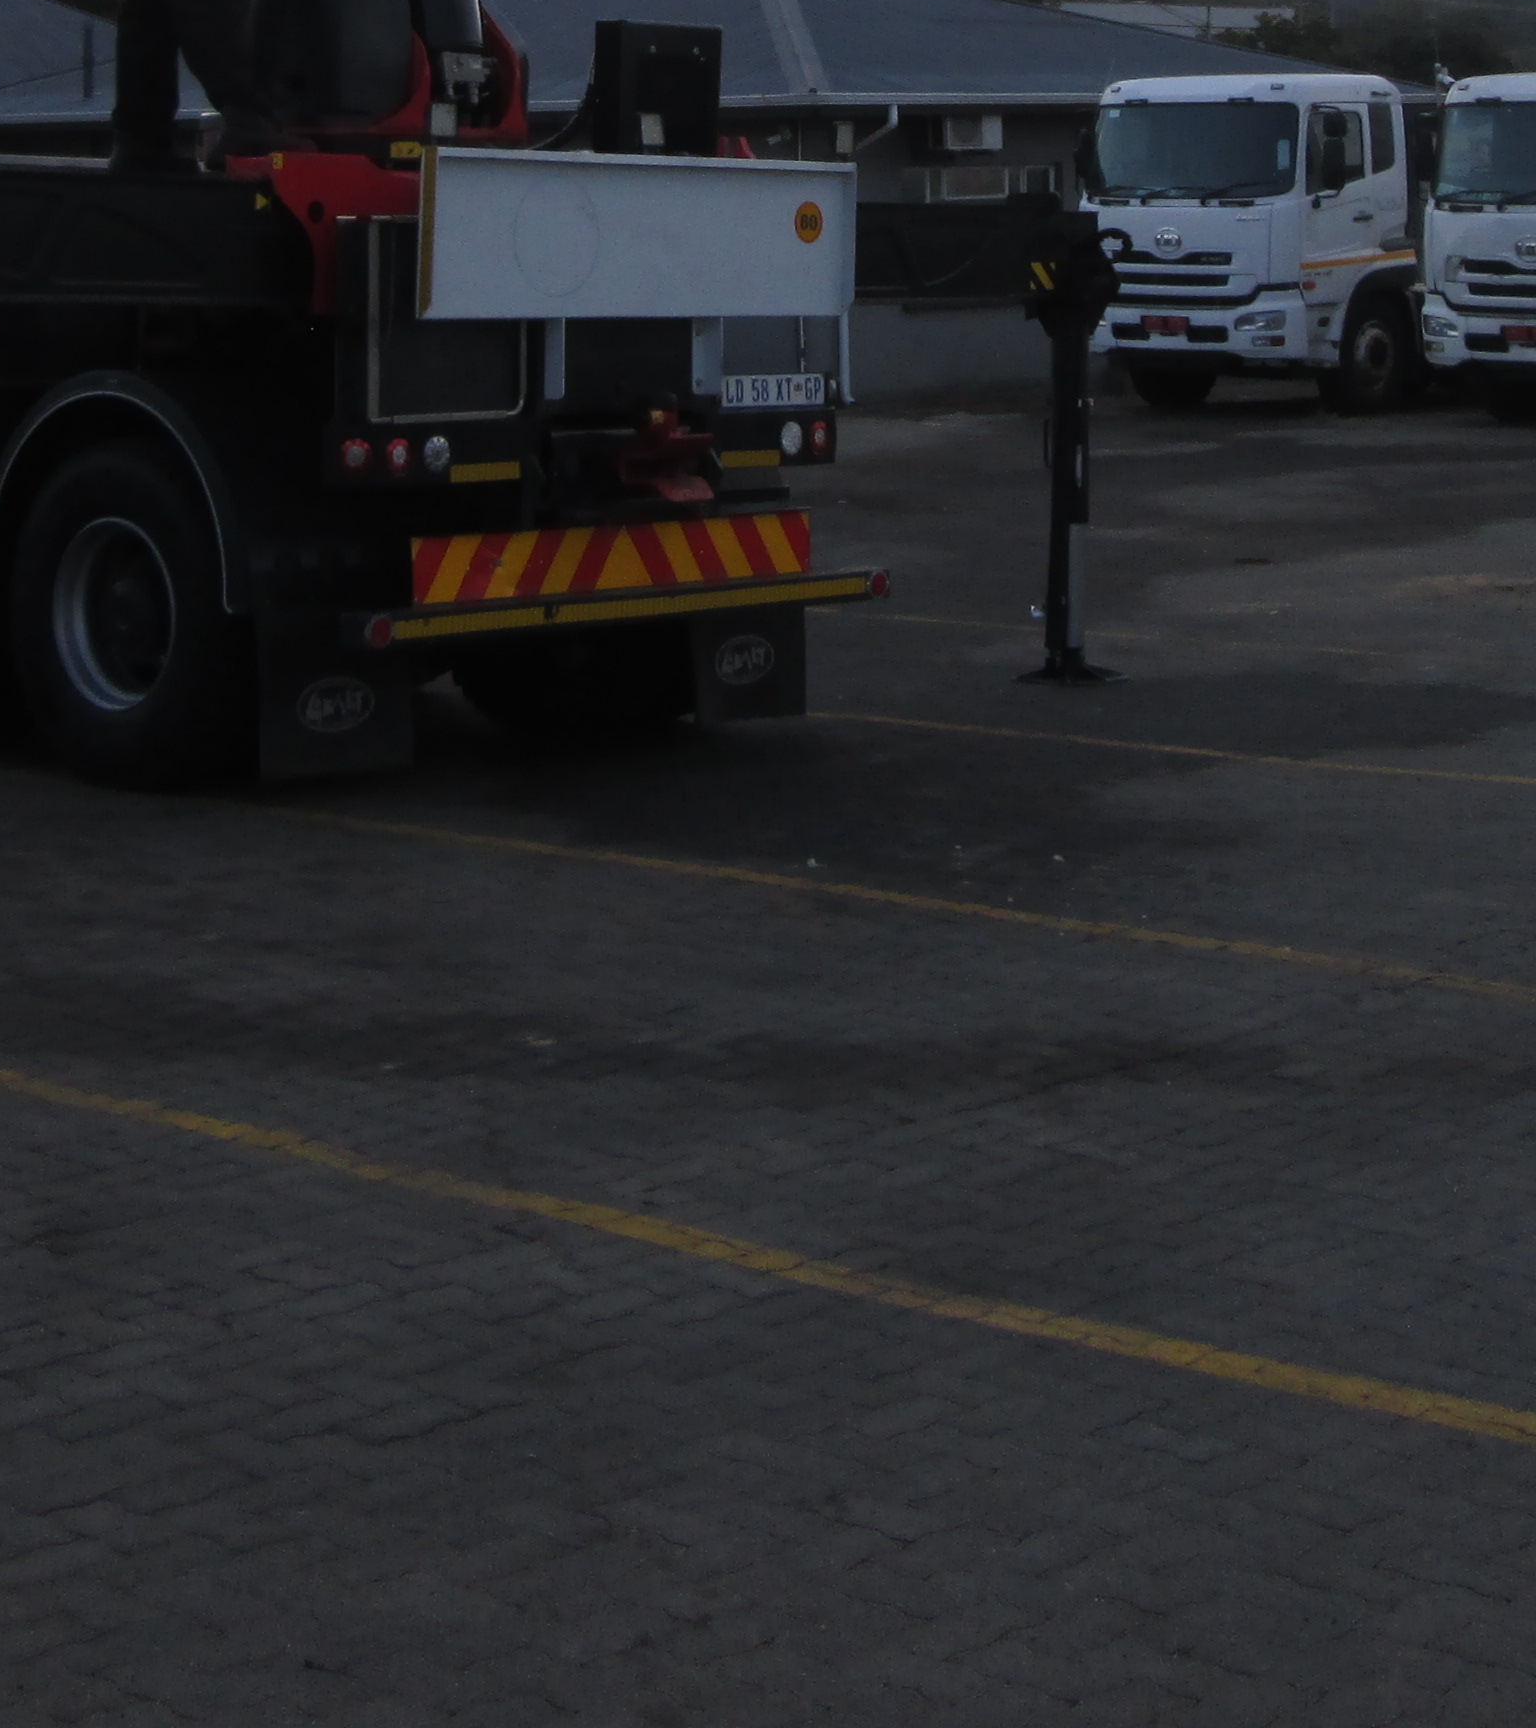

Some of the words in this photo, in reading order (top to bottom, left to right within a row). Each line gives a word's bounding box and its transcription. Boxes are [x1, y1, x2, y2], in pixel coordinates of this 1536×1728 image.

[800, 214, 818, 230] 80
[726, 378, 744, 403] LD
[752, 378, 769, 402] 58
[776, 377, 792, 401] XT
[805, 376, 821, 401] GP
